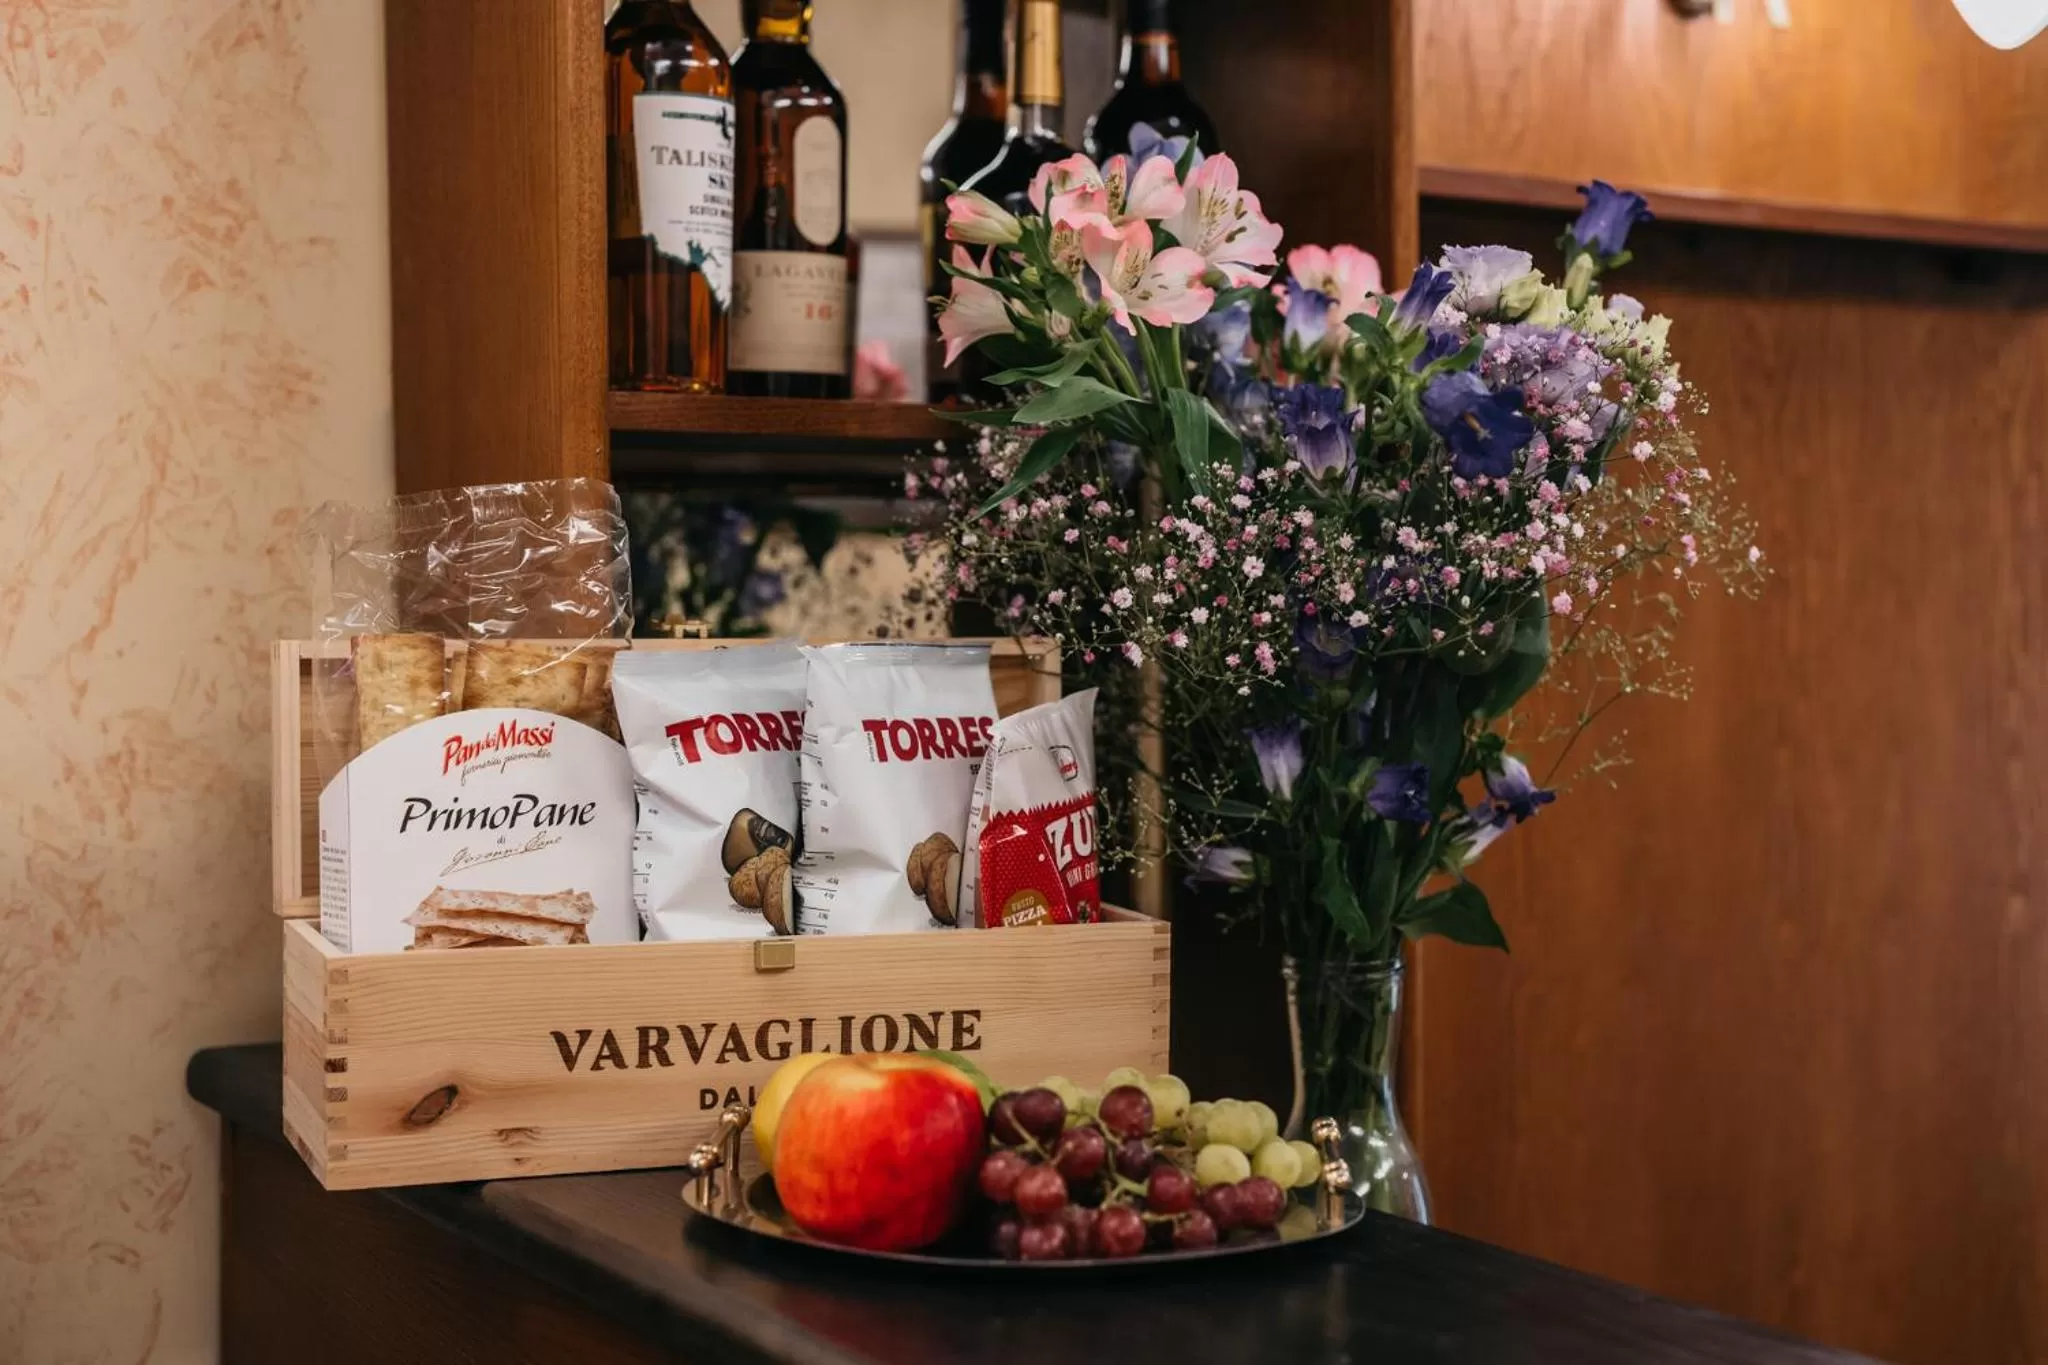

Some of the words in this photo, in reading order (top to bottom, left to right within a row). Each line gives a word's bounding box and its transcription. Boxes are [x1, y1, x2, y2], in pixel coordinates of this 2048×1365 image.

[665, 711, 806, 764] TORRE
[399, 793, 597, 834] PrimoPane
[1002, 904, 1048, 928] PIZZA
[549, 1009, 982, 1073] VARVAGLIONE
